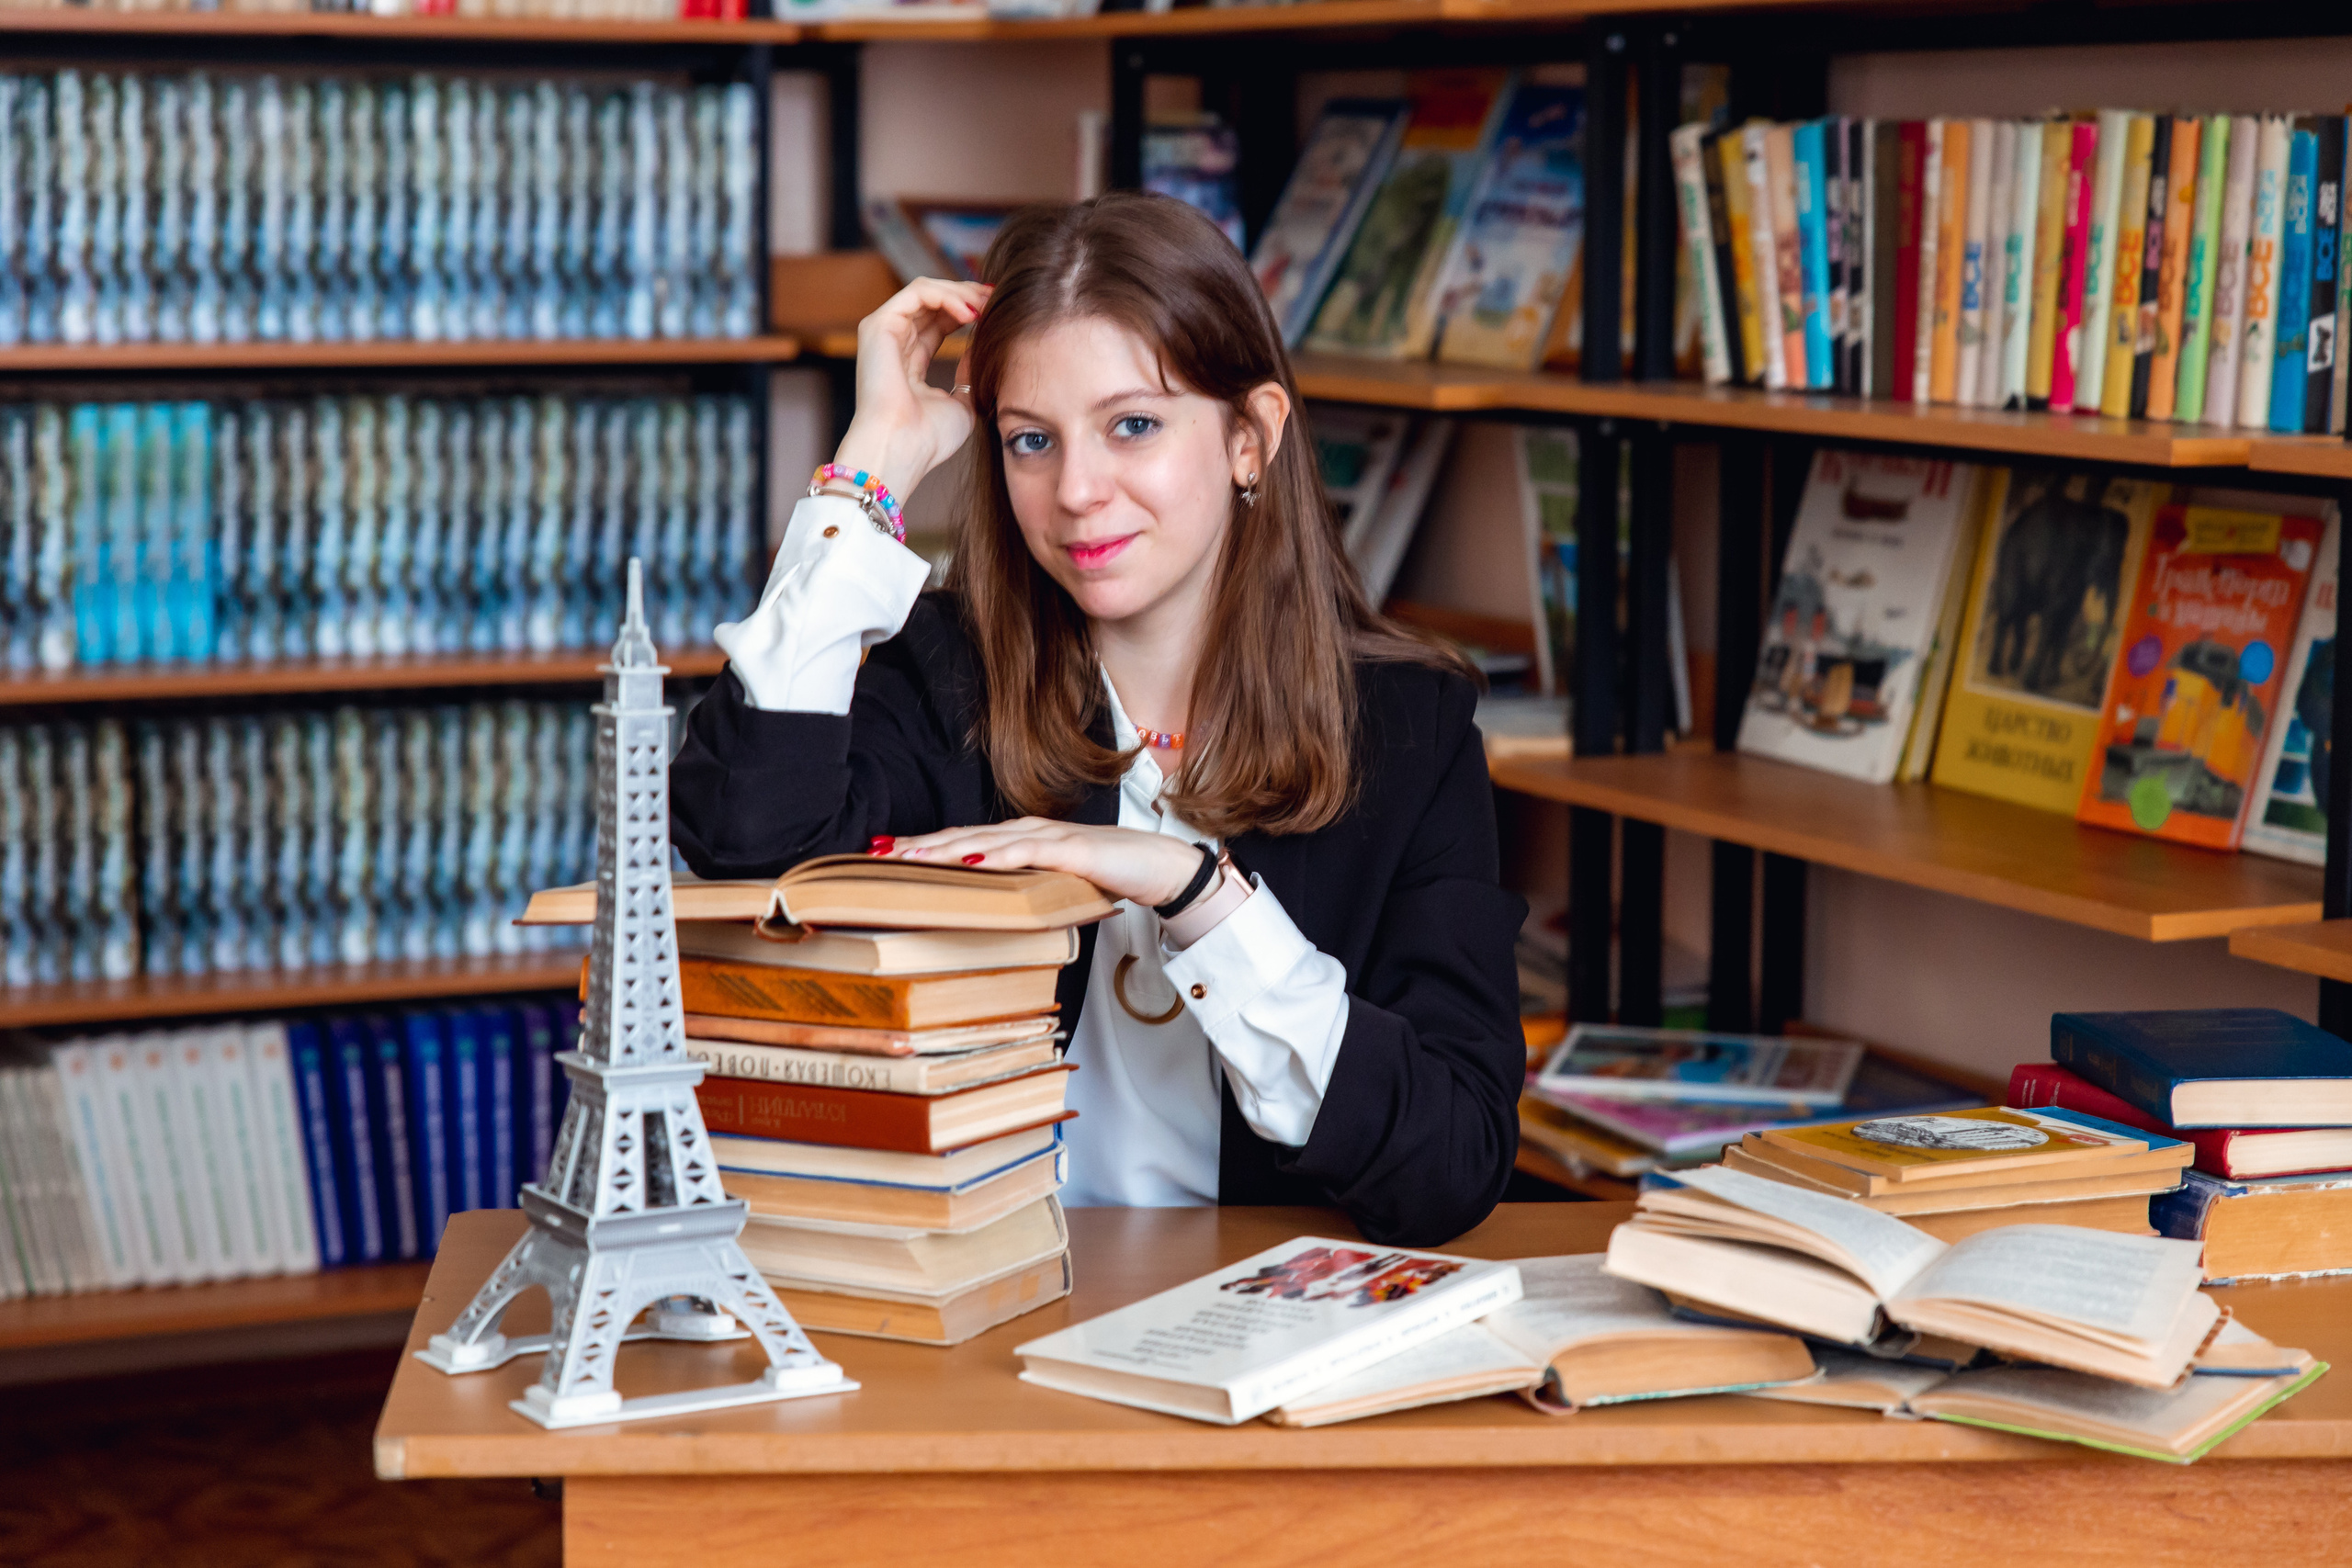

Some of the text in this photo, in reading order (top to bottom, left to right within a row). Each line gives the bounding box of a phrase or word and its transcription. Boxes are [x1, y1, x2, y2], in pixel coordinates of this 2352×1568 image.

[2118, 231, 2141, 308] ВСЕ
[2246, 241, 2274, 320] ВСЕ
[2316, 228, 2336, 283] ВСЕ
